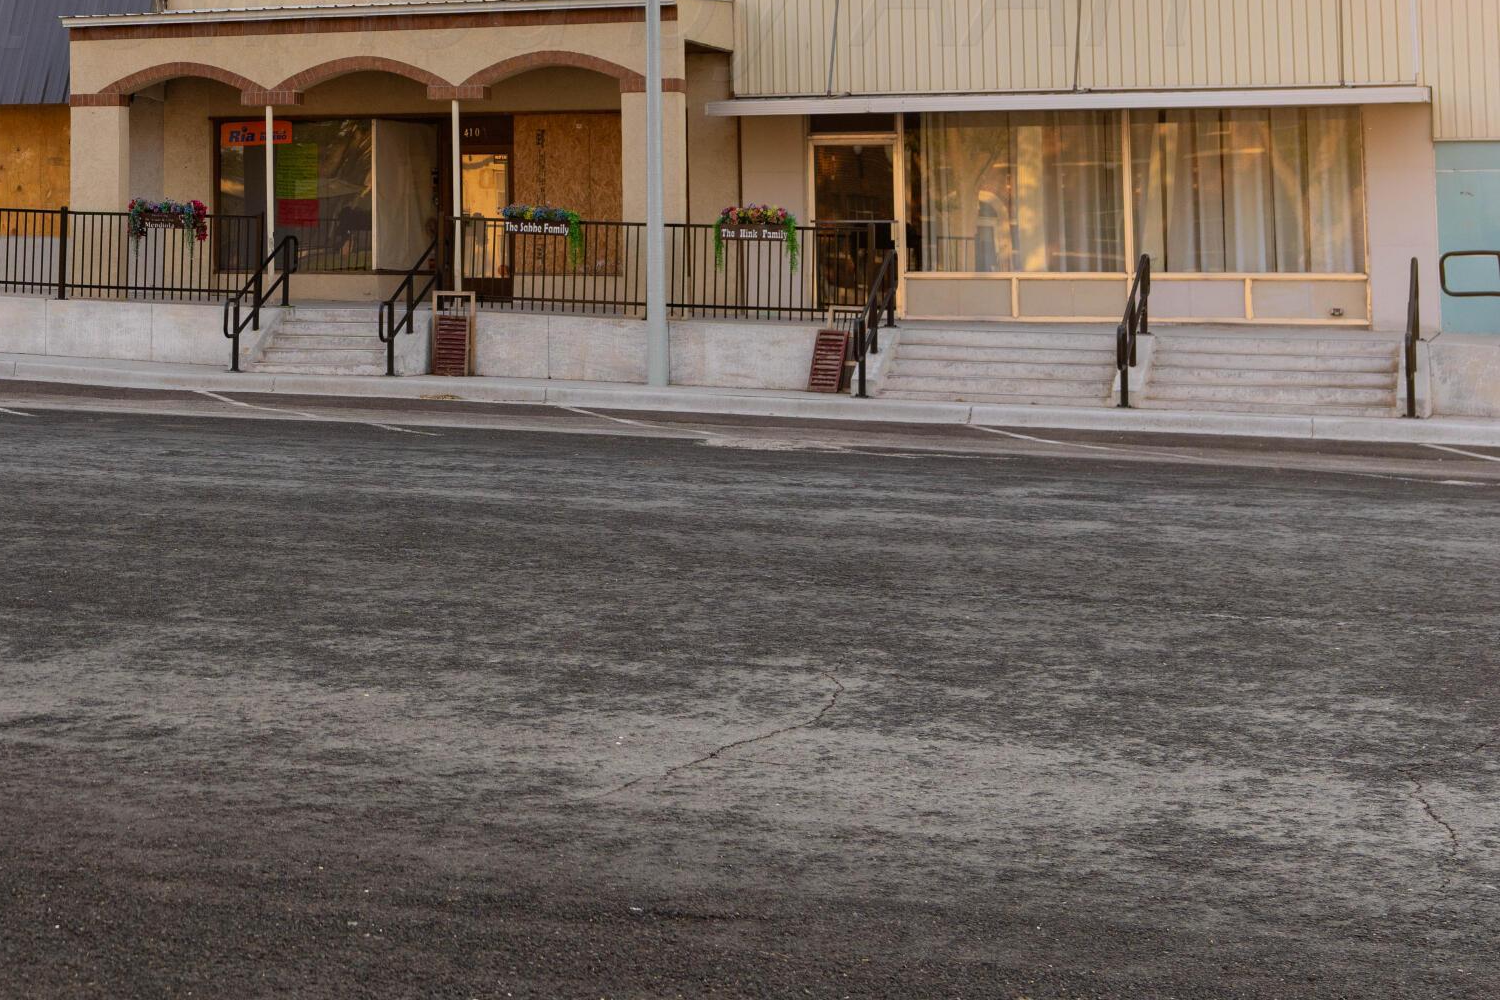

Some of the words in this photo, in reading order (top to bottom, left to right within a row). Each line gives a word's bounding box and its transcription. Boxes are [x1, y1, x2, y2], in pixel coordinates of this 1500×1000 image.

[228, 126, 256, 142] Ria
[505, 221, 518, 232] The
[544, 223, 570, 236] Family
[721, 229, 736, 238] The
[762, 229, 788, 240] Family
